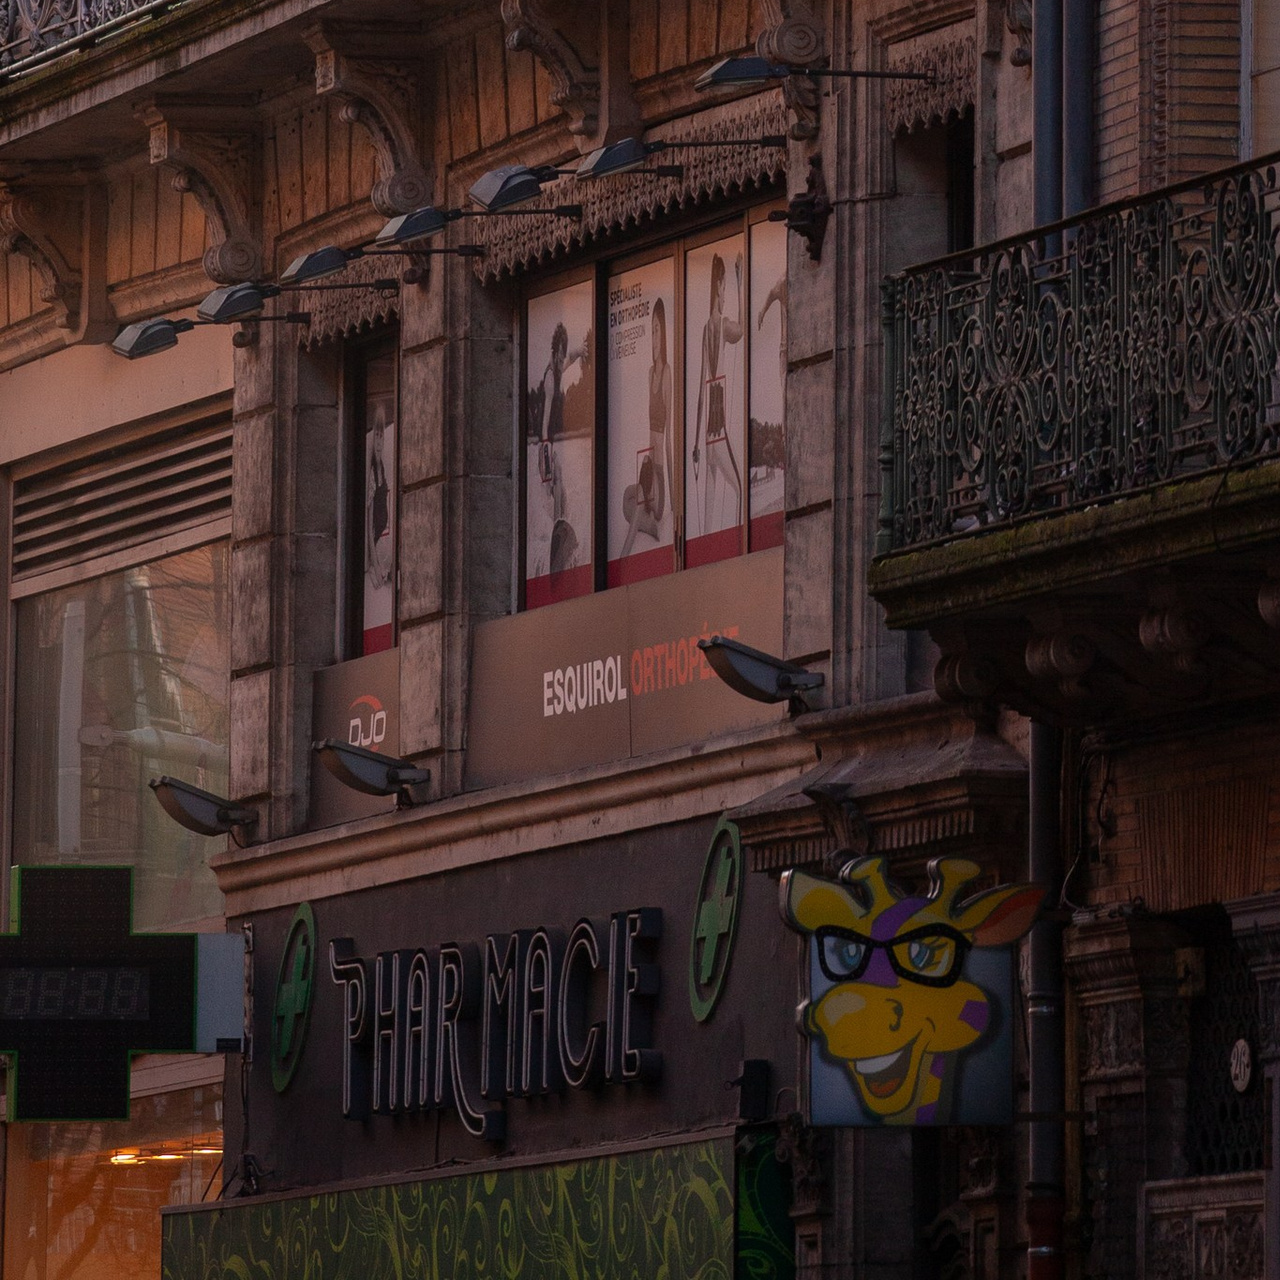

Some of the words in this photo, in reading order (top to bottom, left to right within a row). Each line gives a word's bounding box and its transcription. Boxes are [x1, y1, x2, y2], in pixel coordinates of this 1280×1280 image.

[543, 655, 627, 717] ESQUIROL
[349, 711, 387, 747] DJO
[328, 908, 662, 1140] PHARMACIE
[1233, 1044, 1247, 1081] 26
